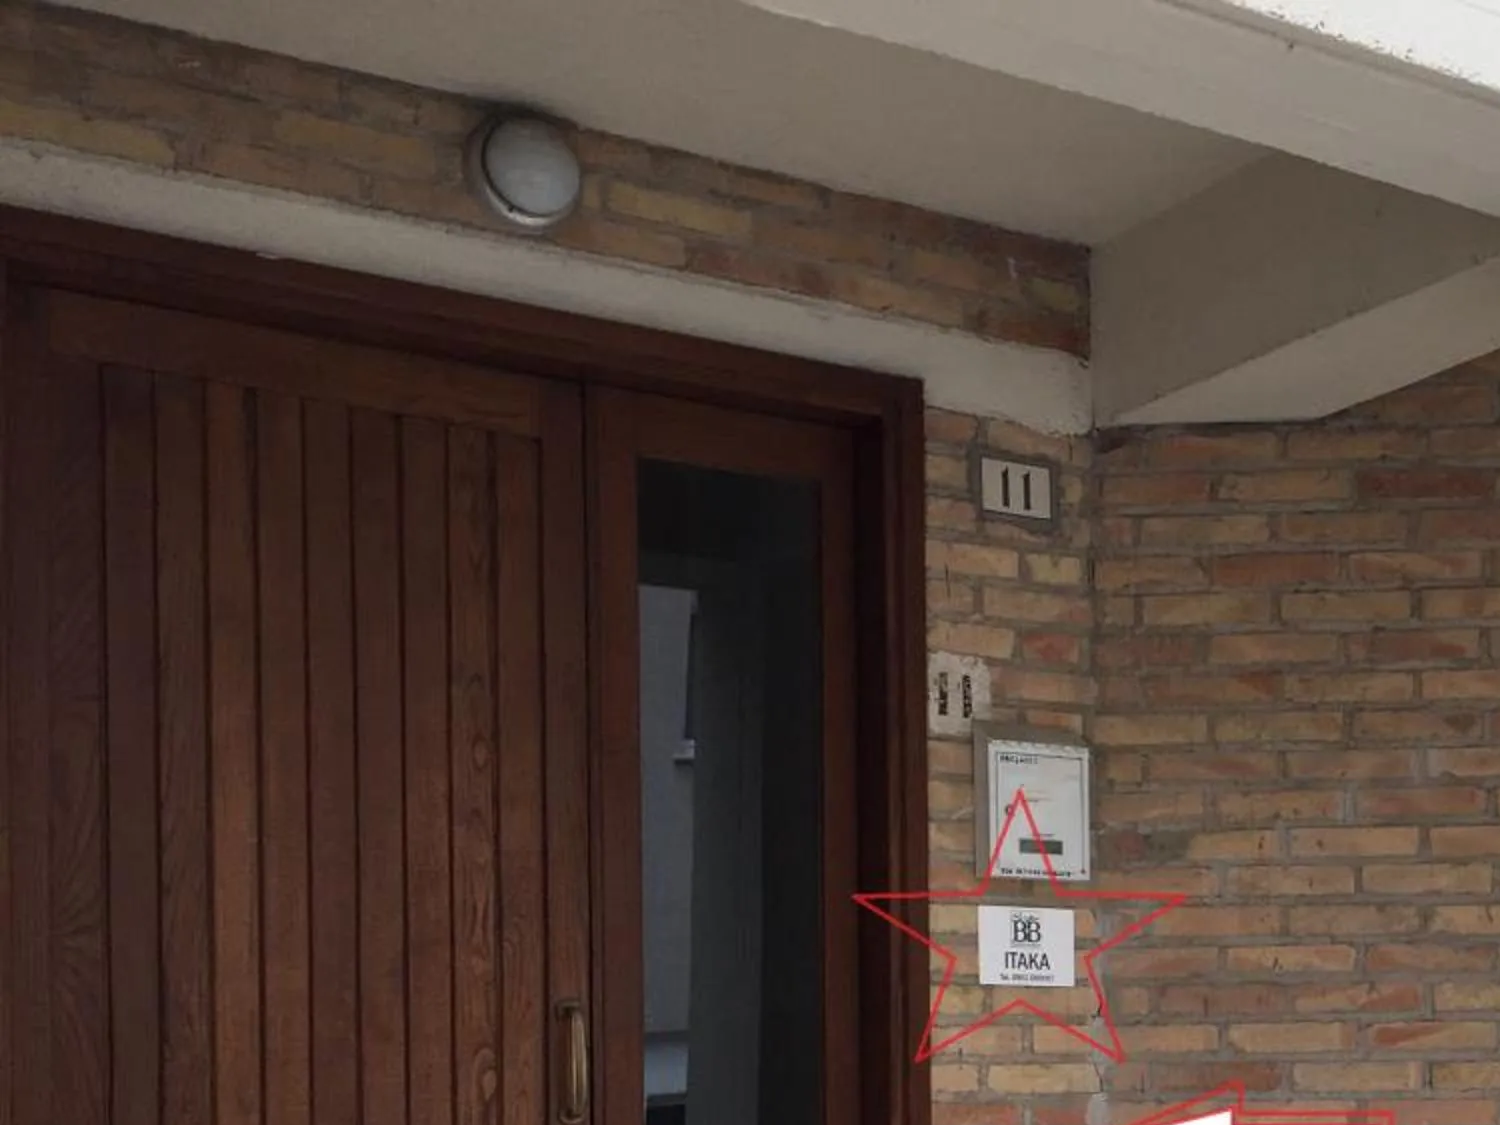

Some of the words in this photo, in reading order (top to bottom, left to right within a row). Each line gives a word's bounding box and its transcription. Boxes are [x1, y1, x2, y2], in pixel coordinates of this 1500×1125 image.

[1001, 464, 1032, 511] 11
[1013, 919, 1041, 943] BB
[1004, 951, 1051, 971] ITAKA
